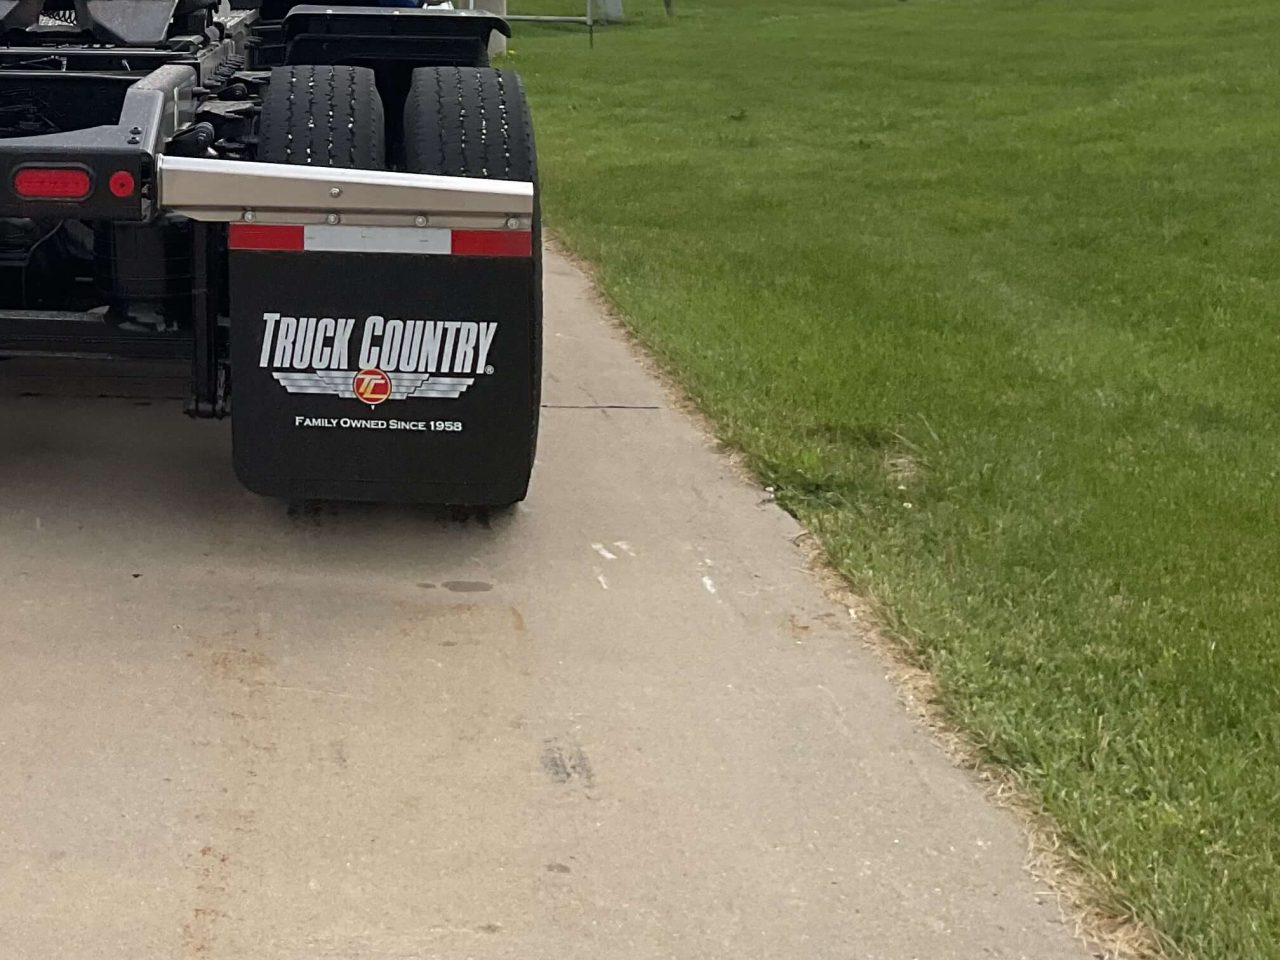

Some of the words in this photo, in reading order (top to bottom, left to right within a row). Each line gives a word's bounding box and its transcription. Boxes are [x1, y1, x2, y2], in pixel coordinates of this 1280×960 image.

[259, 312, 355, 369] TRUCK
[358, 315, 498, 374] COUNTRY
[295, 415, 339, 428] FAMILY
[340, 417, 387, 430] OWNED
[389, 419, 427, 431] SINCE
[429, 421, 463, 432] 1958
